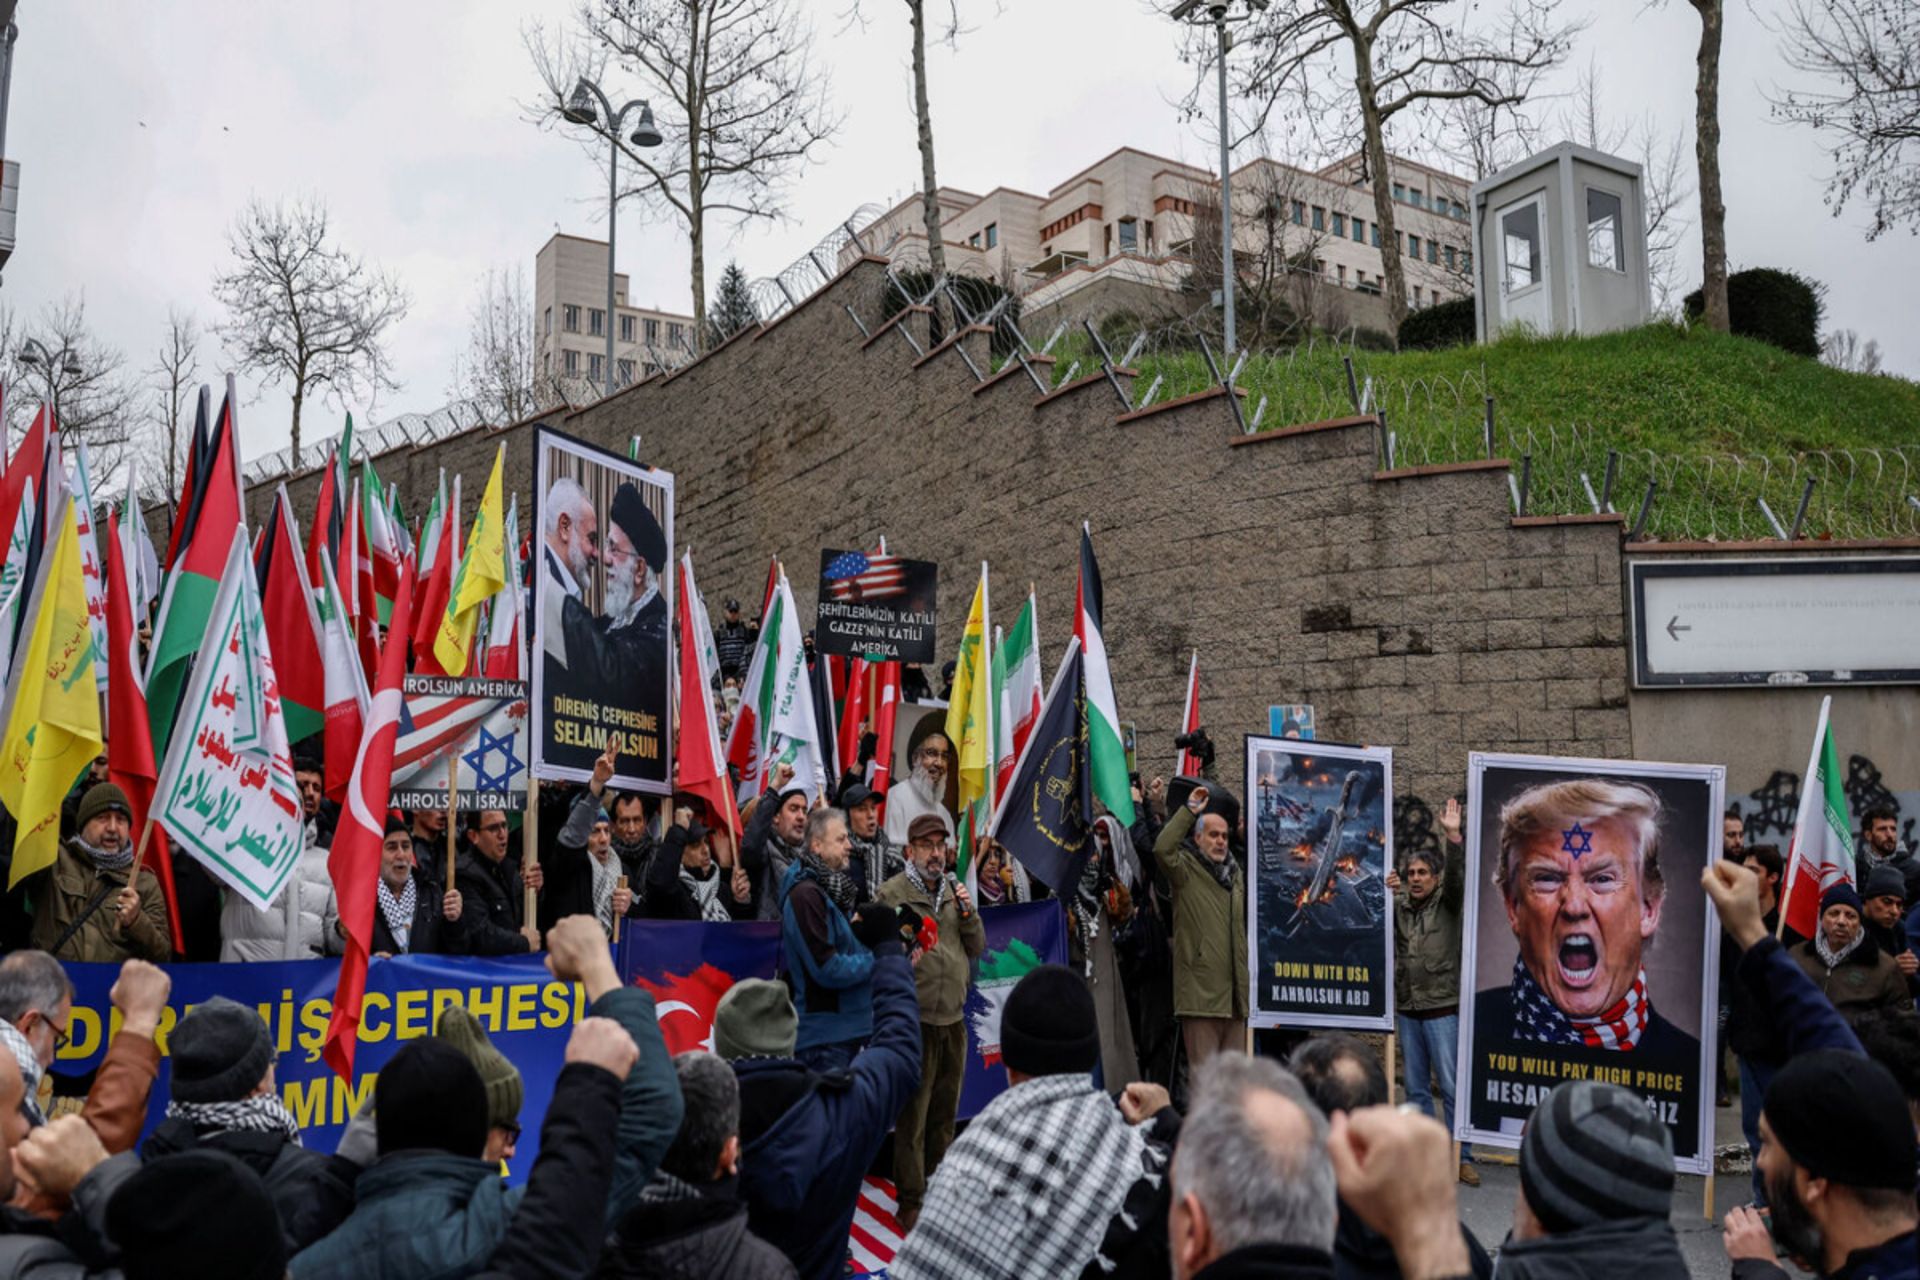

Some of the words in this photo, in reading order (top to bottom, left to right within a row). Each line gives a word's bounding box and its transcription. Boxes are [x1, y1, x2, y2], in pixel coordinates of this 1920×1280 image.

[900, 611, 934, 625] KATİLİ
[829, 621, 885, 638] GAZZE'NİN
[888, 627, 922, 641] KATİLİ
[851, 641, 898, 656] AMERİKA
[403, 678, 463, 694] ROLSUN
[467, 681, 525, 698] AMERİKA
[553, 693, 600, 725] DİRENİŞ
[602, 705, 657, 733] CEPHESİNE
[554, 719, 608, 751] SELAM
[610, 730, 658, 760] OLSUN
[387, 793, 471, 810] AHROLSN
[476, 790, 519, 810] İSRAİL
[1274, 962, 1310, 979] DOWN
[1313, 964, 1343, 981] WITH
[1347, 966, 1369, 982] USA
[1272, 985, 1343, 1005] KAHROLSUN
[1346, 990, 1370, 1006] ABD
[1489, 1053, 1517, 1072] YOU
[1521, 1057, 1557, 1077] WILL
[1562, 1061, 1589, 1080] PAY
[1594, 1066, 1631, 1086] HIGH
[1636, 1070, 1683, 1092] PRICE
